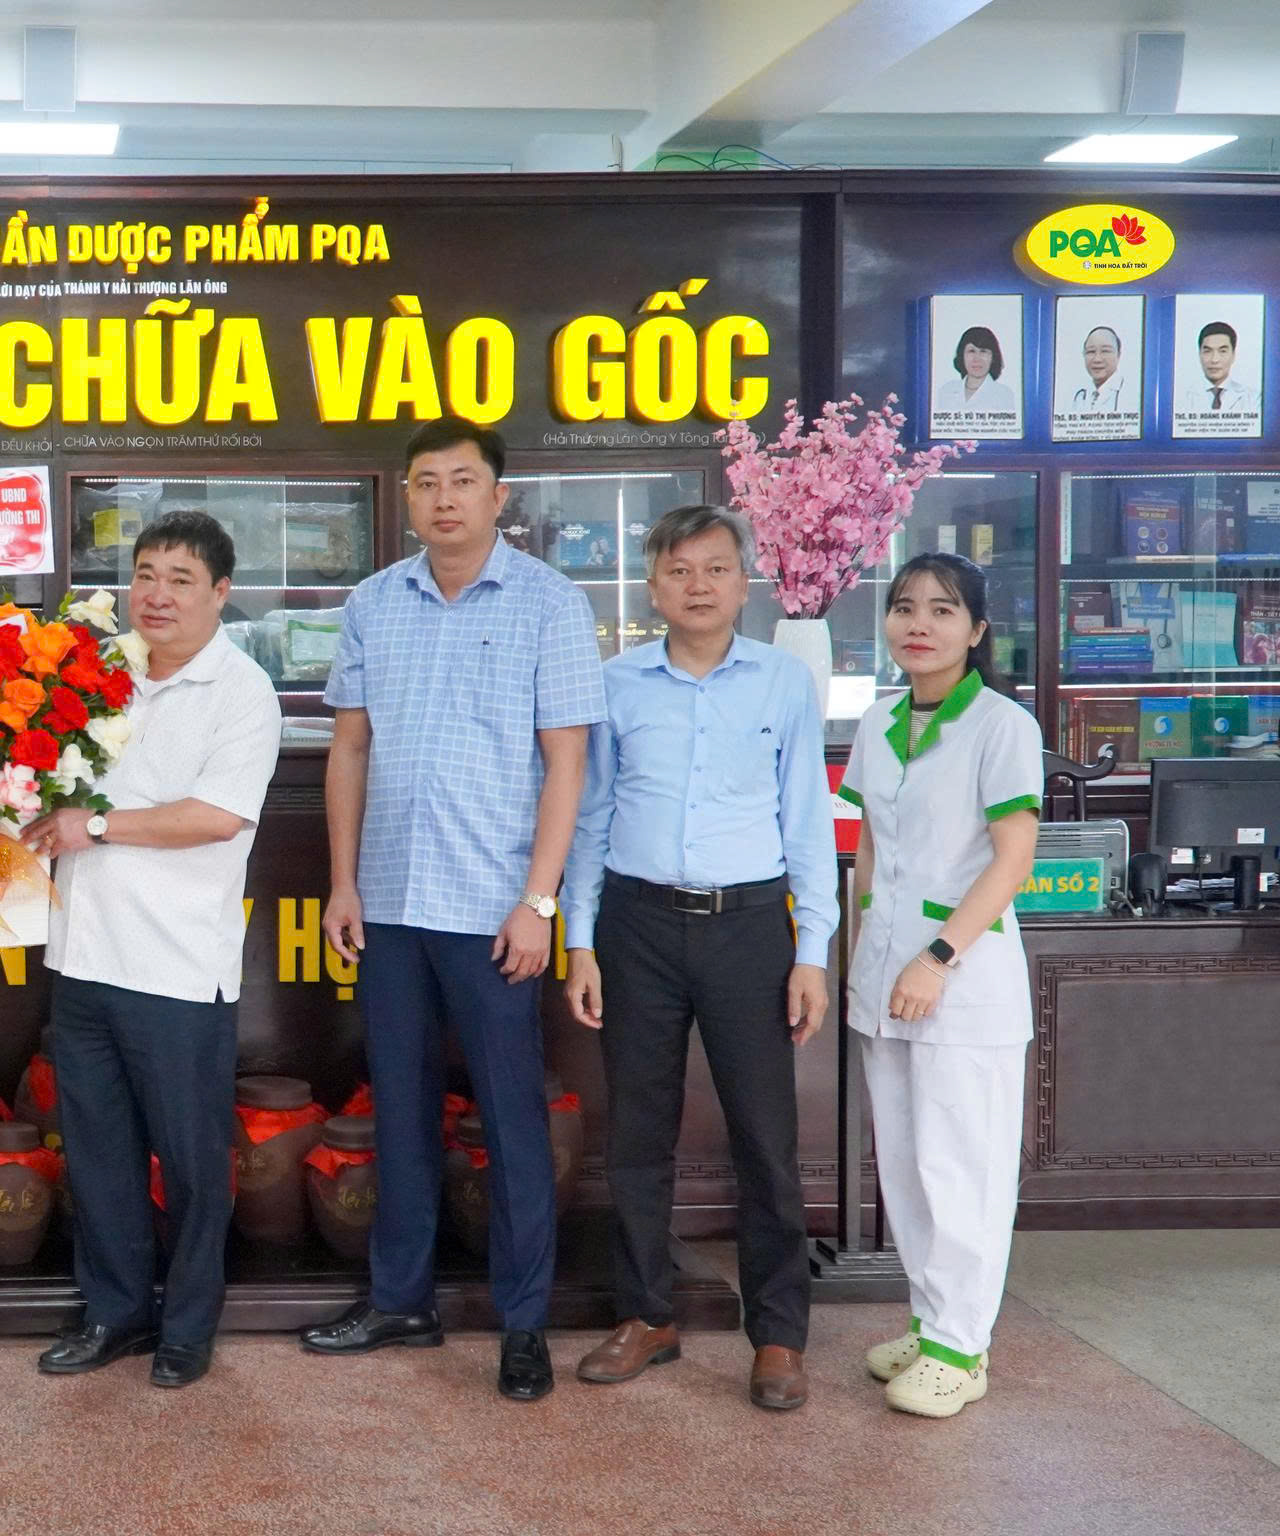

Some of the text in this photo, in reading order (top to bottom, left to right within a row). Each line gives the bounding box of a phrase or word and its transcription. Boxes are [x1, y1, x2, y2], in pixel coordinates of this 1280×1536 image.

[68, 220, 172, 272] DƯỢC
[184, 200, 300, 264] PHẨM
[312, 224, 391, 267] PQA
[1049, 228, 1122, 258] PQA
[16, 284, 36, 300] DẠY
[39, 280, 62, 297] CỦA
[64, 280, 101, 295] THÁNH
[103, 282, 111, 294] Y
[112, 278, 131, 294] HẢI
[133, 281, 177, 297] THƯỢNG
[180, 279, 202, 294] LÃN
[204, 279, 228, 294] ÔNG
[306, 294, 518, 428] VÀO
[553, 277, 771, 427] GỐC
[933, 412, 952, 420] DƯỢC
[988, 412, 1017, 420] PHƯƠNG
[25, 436, 53, 452] KHỎI
[64, 434, 97, 448] CHỮA
[99, 434, 125, 448] VÀO
[127, 435, 164, 450] NGỌN
[569, 432, 615, 447] Thượng
[641, 433, 667, 447] Ông
[669, 433, 677, 444] Y
[1, 488, 27, 503] UBND
[25, 509, 41, 525] THI
[1056, 872, 1084, 893] SỐ
[1087, 876, 1100, 893] 2
